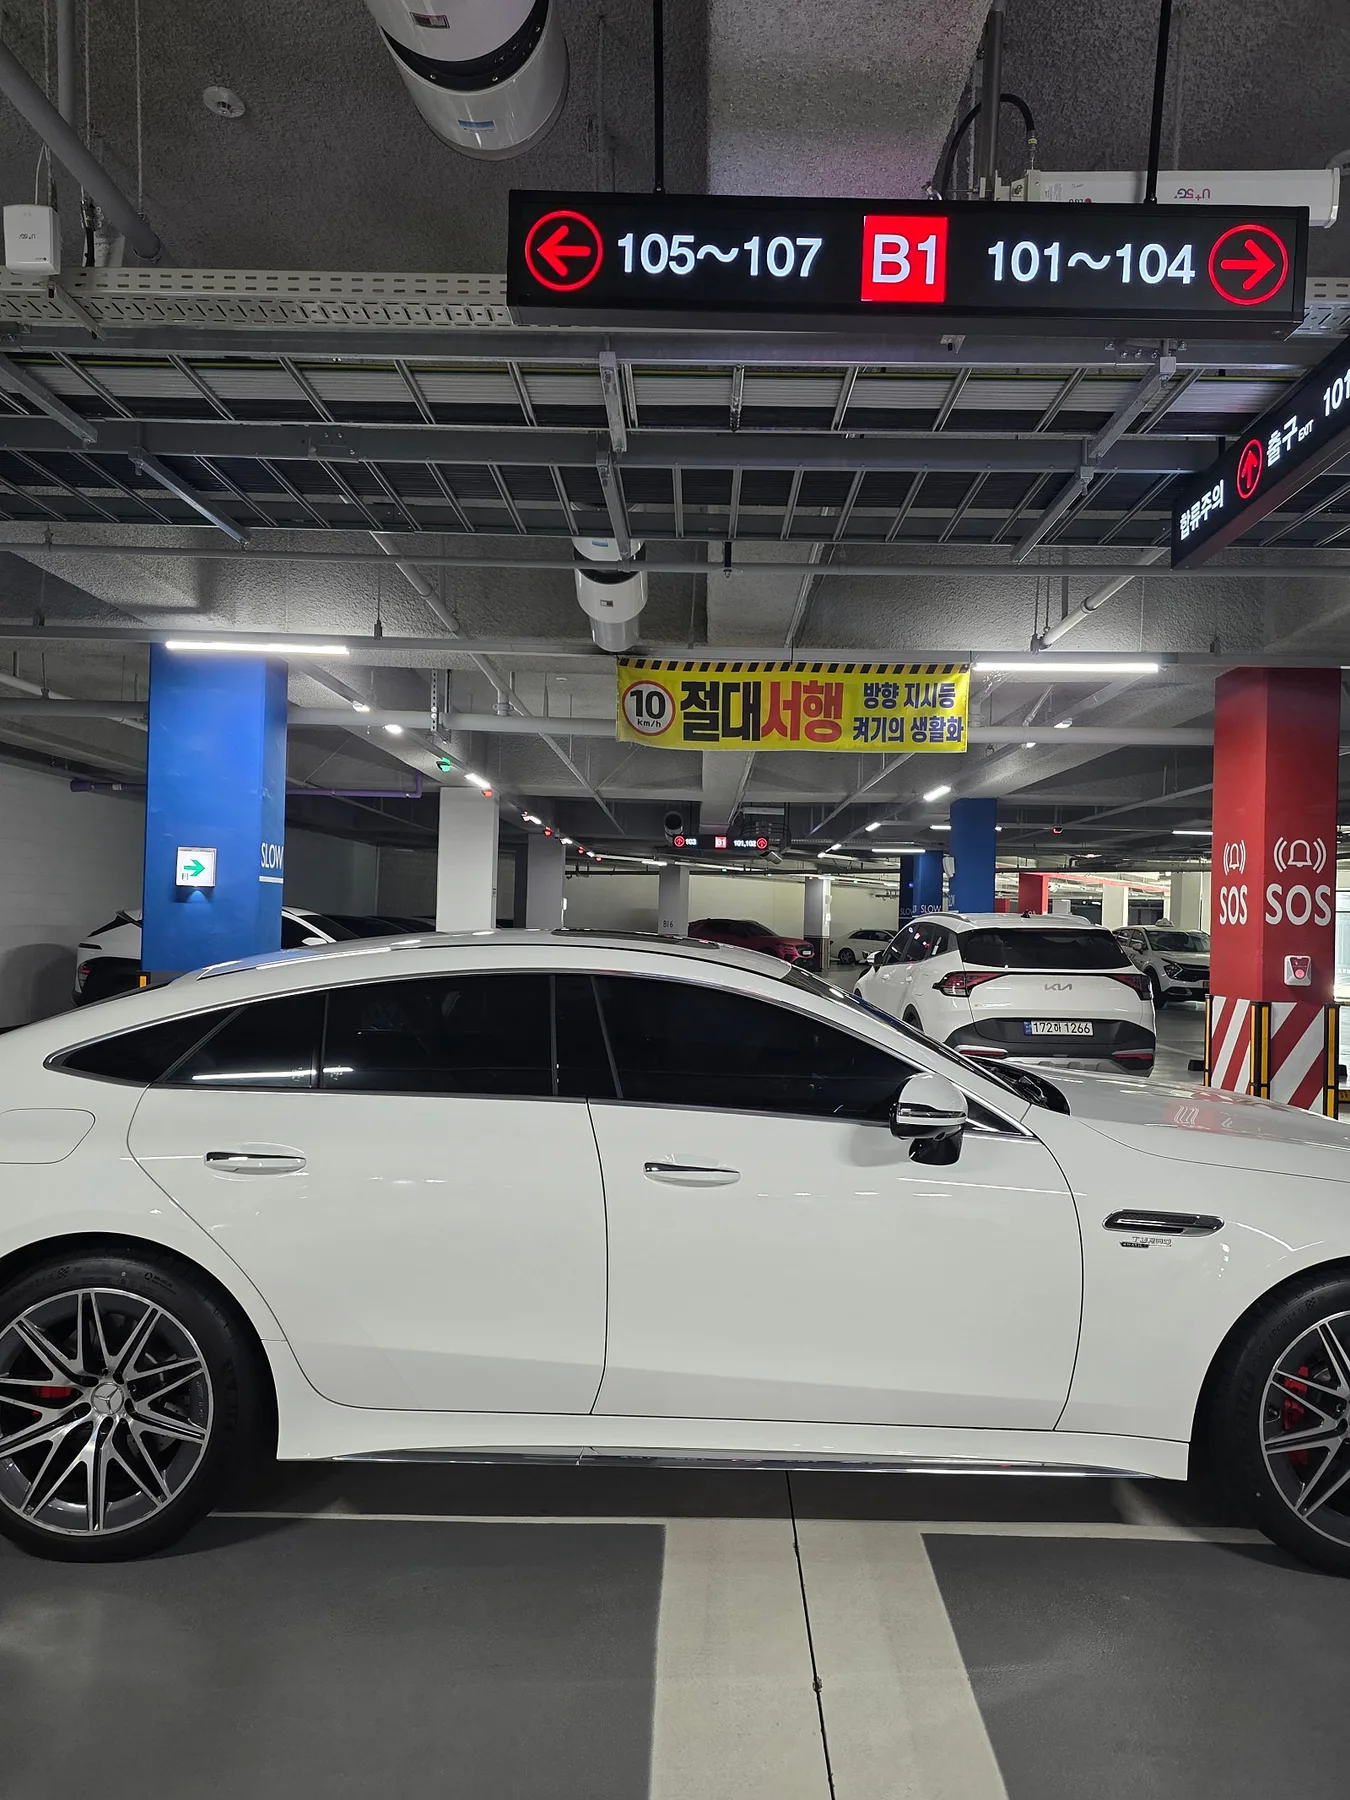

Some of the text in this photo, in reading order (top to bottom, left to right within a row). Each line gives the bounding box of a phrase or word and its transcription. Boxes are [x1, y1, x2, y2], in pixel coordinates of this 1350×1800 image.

[617, 232, 1196, 285] 105~107 B1 101~104
[1179, 478, 1225, 541] 합류주의
[1266, 414, 1299, 468] 출구
[1298, 418, 1315, 443] EXIT
[629, 688, 667, 720] 10
[863, 681, 957, 710] 방향 지시등
[637, 718, 662, 729] km/h
[852, 715, 965, 744] 켜기의 생활화
[260, 842, 285, 871] SLOW
[920, 904, 942, 914] SLOW
[1219, 883, 1249, 926] SOS
[1265, 882, 1332, 927] SOS
[1044, 982, 1073, 991] KIA
[1065, 1022, 1091, 1034] 1266
